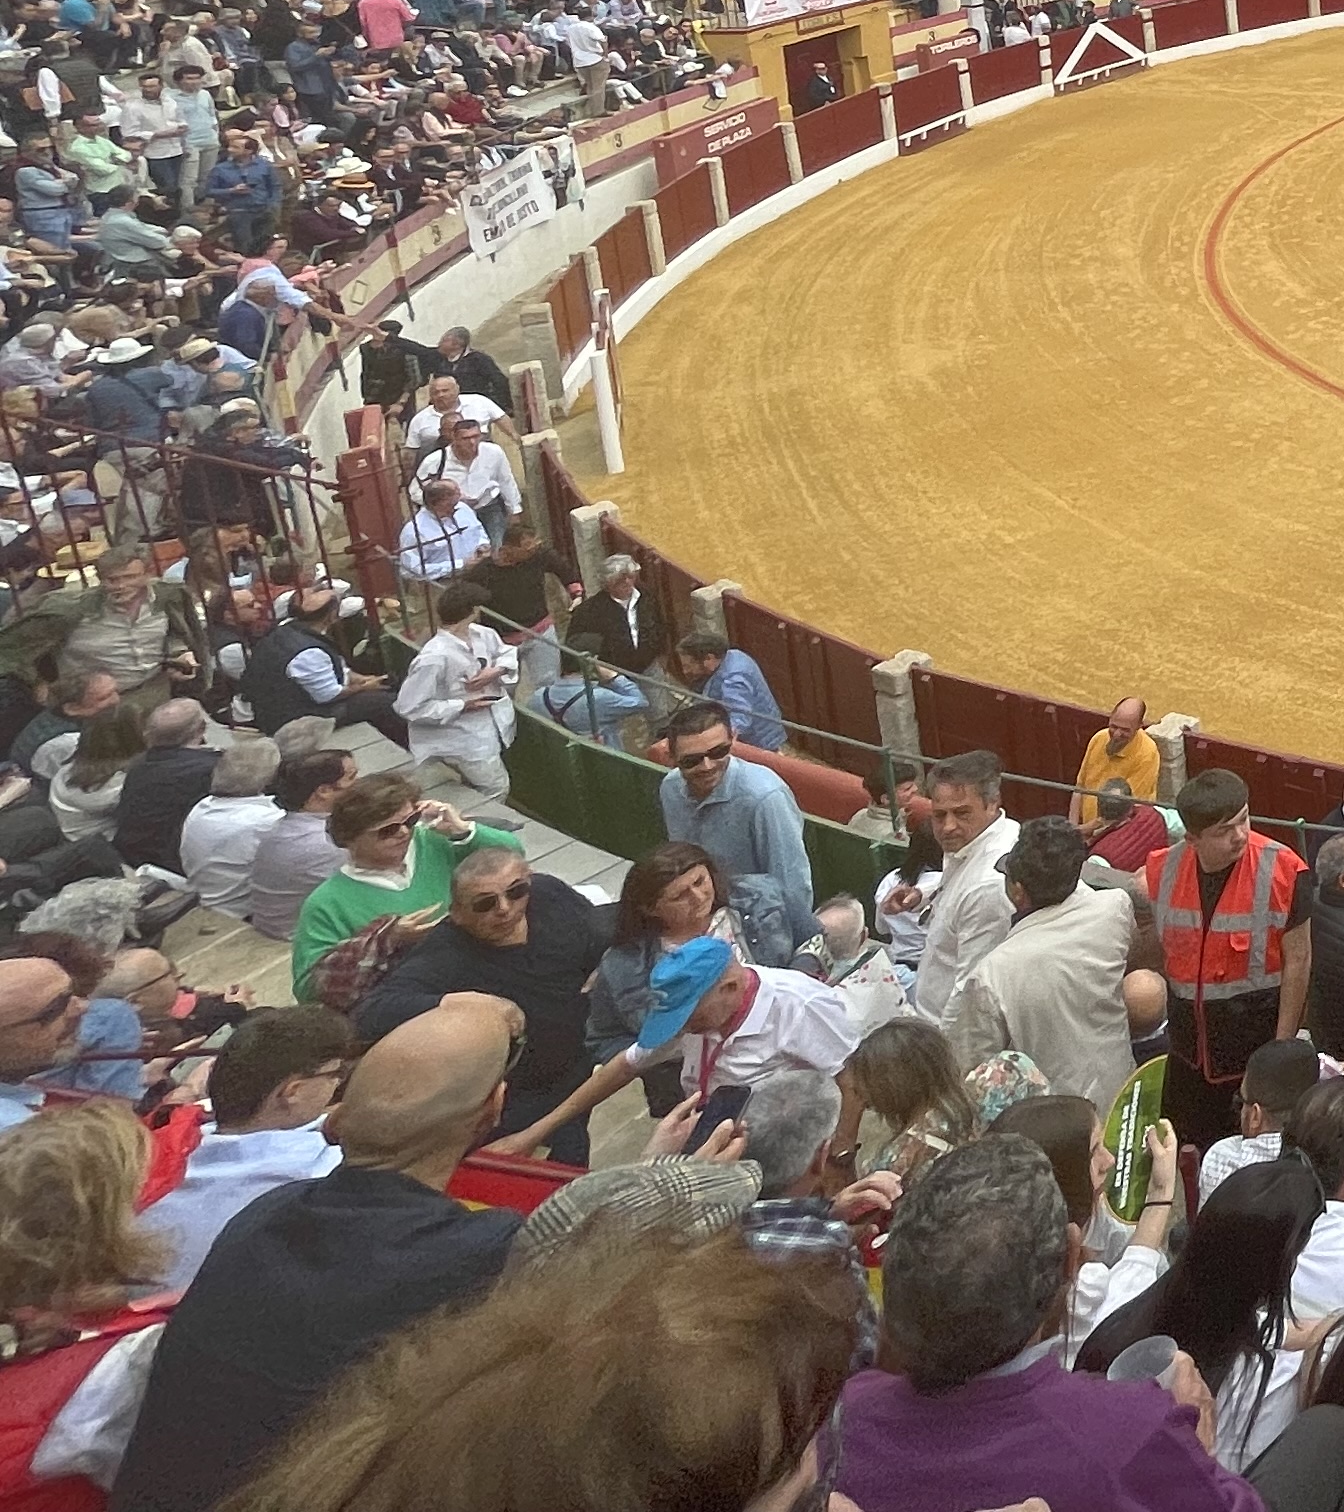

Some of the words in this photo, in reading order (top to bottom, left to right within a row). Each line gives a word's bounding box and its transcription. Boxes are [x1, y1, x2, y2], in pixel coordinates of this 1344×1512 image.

[704, 112, 746, 138] SERVICIO
[707, 139, 723, 153] DE
[721, 126, 752, 149] PLAZA
